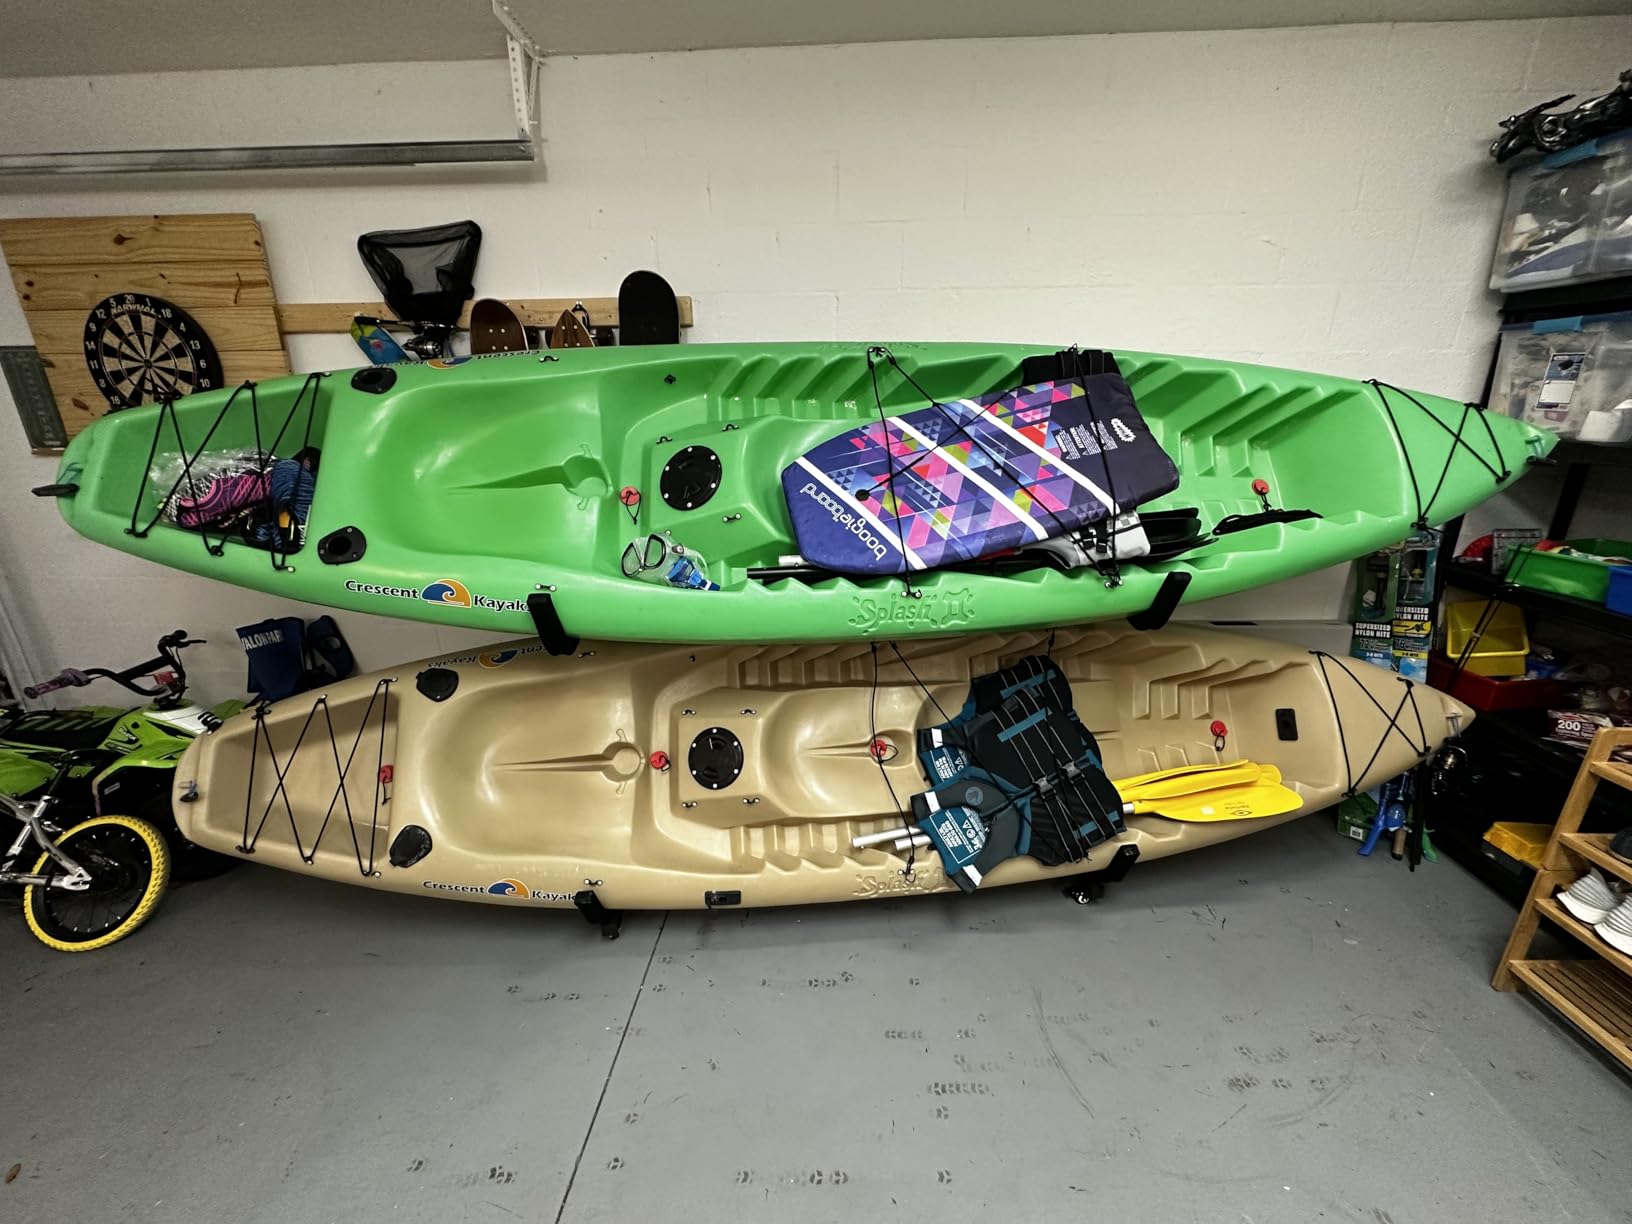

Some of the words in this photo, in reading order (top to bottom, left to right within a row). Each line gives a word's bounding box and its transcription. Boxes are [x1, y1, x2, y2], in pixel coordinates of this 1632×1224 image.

[109, 298, 116, 308] 5
[124, 294, 135, 304] 20
[145, 298, 152, 307] 1
[95, 308, 107, 320] 12
[161, 308, 172, 319] 18
[89, 322, 97, 333] 9
[179, 322, 187, 332] 4
[85, 341, 96, 351] 14
[189, 340, 201, 351] 13
[89, 359, 99, 370] 11
[199, 359, 207, 369] 6
[199, 379, 211, 388] 10
[110, 395, 121, 405] 16
[800, 482, 888, 561] boogieboard
[344, 579, 419, 600] Crescent
[473, 594, 529, 613] Kayak
[856, 594, 932, 635] Splash
[1354, 629, 1374, 637] NYLON
[1557, 719, 1582, 732] 200
[423, 880, 486, 894] Crescent
[532, 890, 577, 901] Kayak
